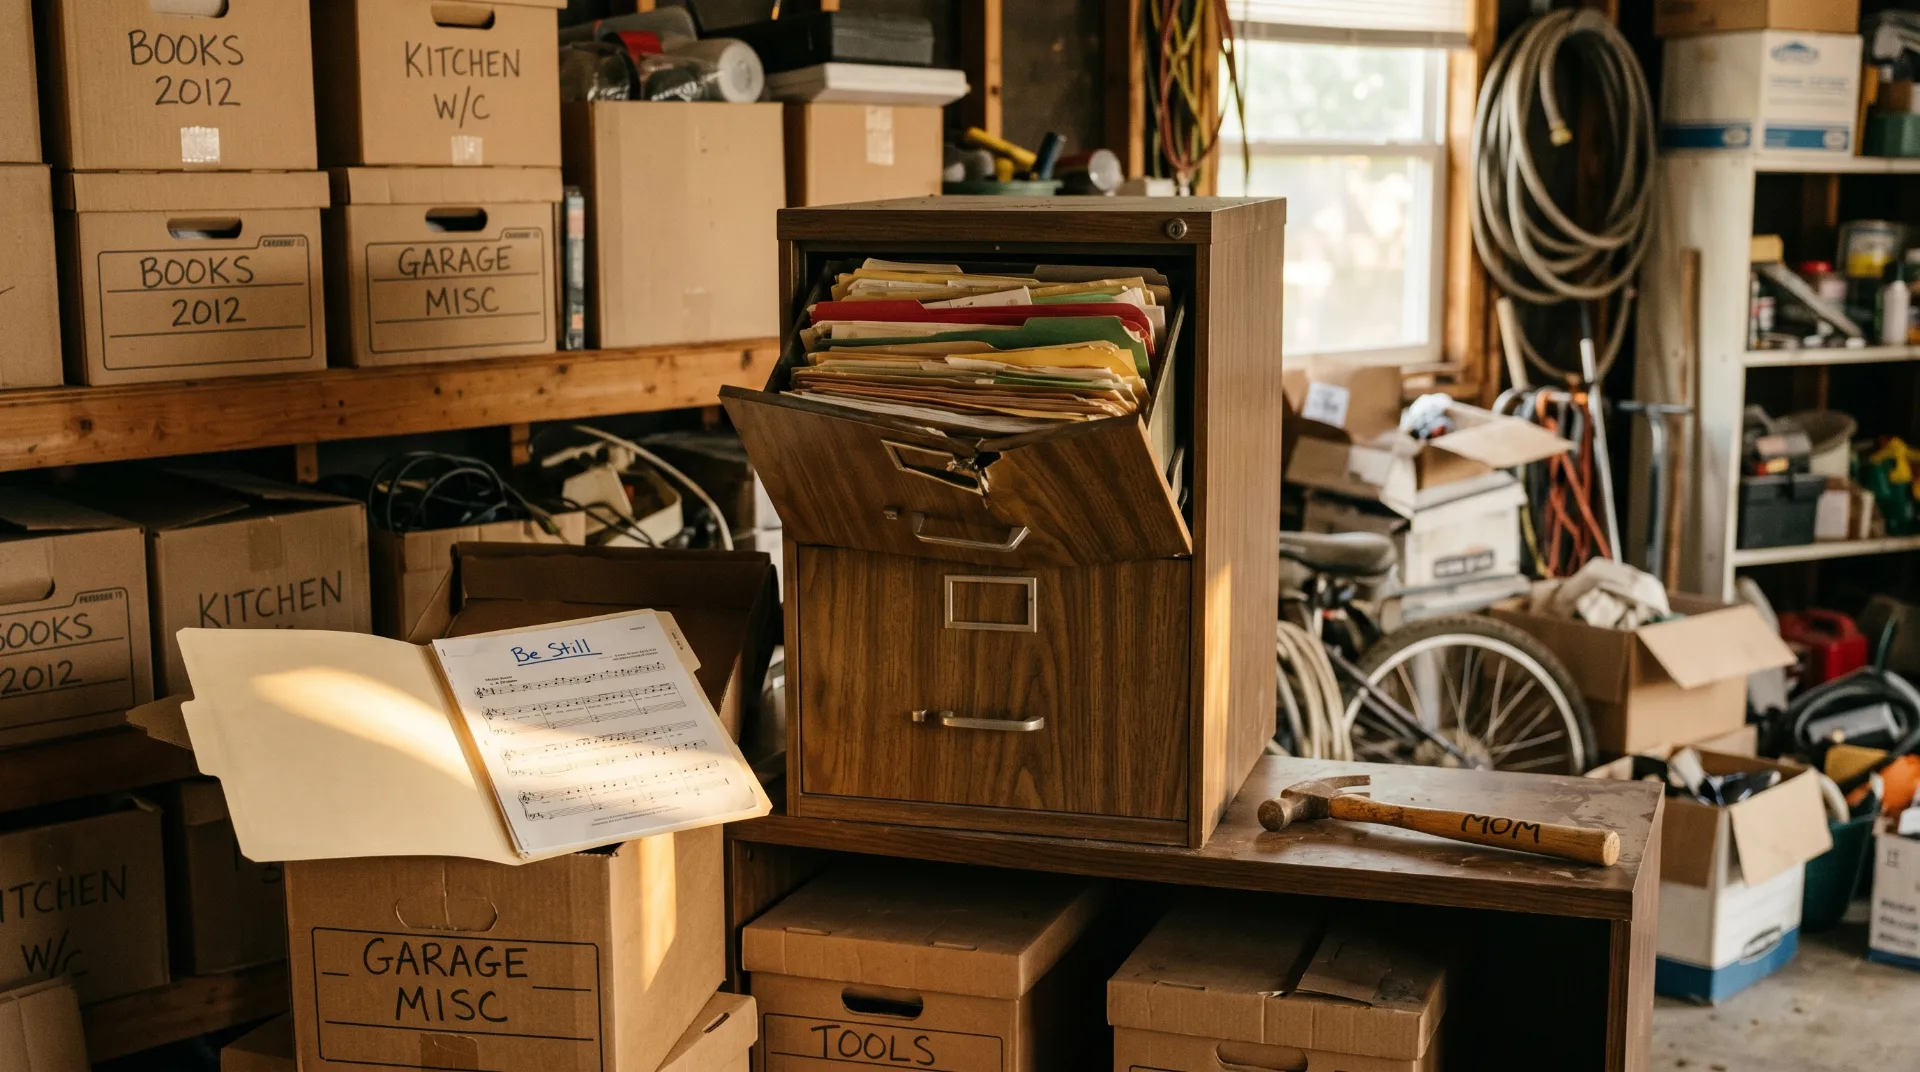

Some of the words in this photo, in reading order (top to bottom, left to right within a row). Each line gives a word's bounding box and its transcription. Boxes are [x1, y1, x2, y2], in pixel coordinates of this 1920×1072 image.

[128, 29, 244, 66] BOOKS
[405, 42, 521, 78] KITCHEN
[155, 76, 241, 106] 2012
[434, 86, 490, 128] W/C
[140, 255, 254, 288] BOOKS
[399, 245, 512, 279] GARAGE
[172, 297, 246, 327] 2012
[425, 286, 499, 316] MISC
[199, 569, 342, 628] KITCHEN
[0, 612, 92, 651] OOKS
[511, 646, 541, 663] Be
[547, 638, 591, 658] Still
[0, 660, 82, 694] 2012
[1461, 813, 1540, 844] MOM
[21, 928, 89, 977] W/C
[363, 937, 528, 978] GARAGE
[395, 985, 508, 1023] MISC
[811, 1024, 935, 1066] TOOLS
